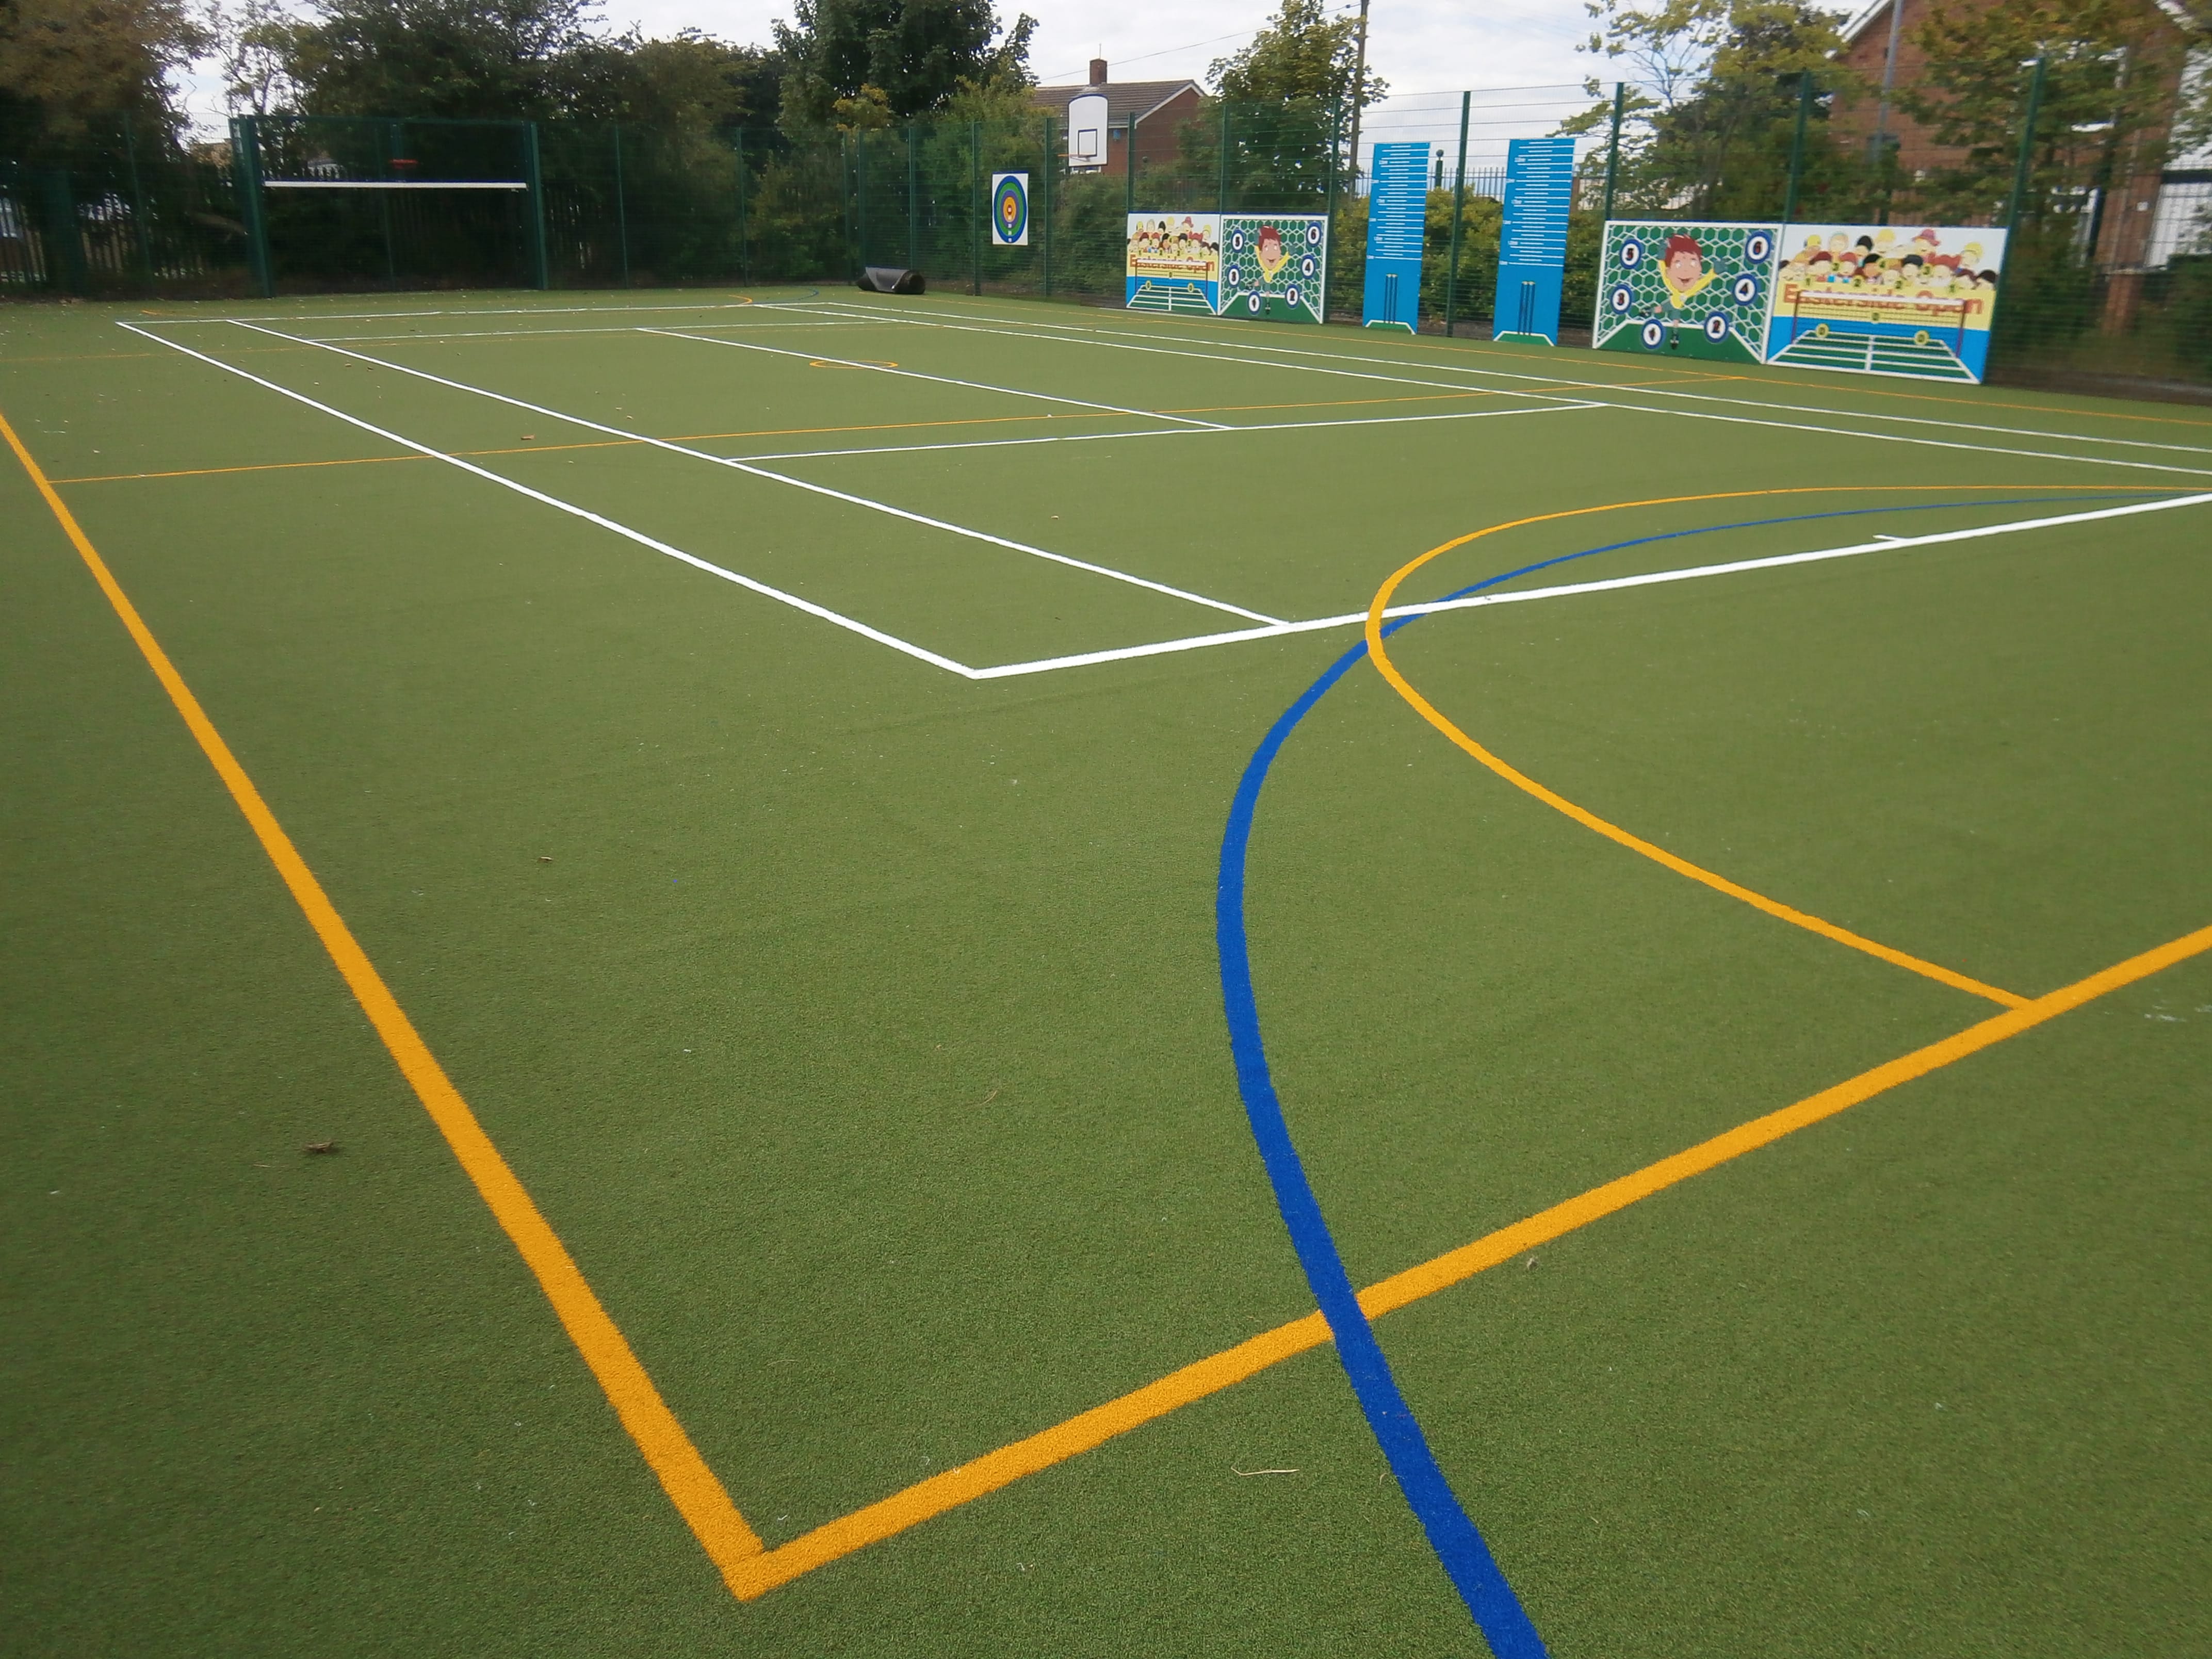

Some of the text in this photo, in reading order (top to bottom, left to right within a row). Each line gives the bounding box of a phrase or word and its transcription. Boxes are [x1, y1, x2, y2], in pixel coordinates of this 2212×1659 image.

[1310, 229, 1316, 240] 6
[1235, 236, 1240, 247] 5
[1626, 247, 1634, 261] 5
[1305, 262, 1311, 272] 4
[1231, 271, 1236, 282] 3
[1738, 282, 1748, 296] 4
[1290, 290, 1295, 301] 2
[1617, 292, 1625, 306] 3
[1712, 320, 1720, 333] 2
